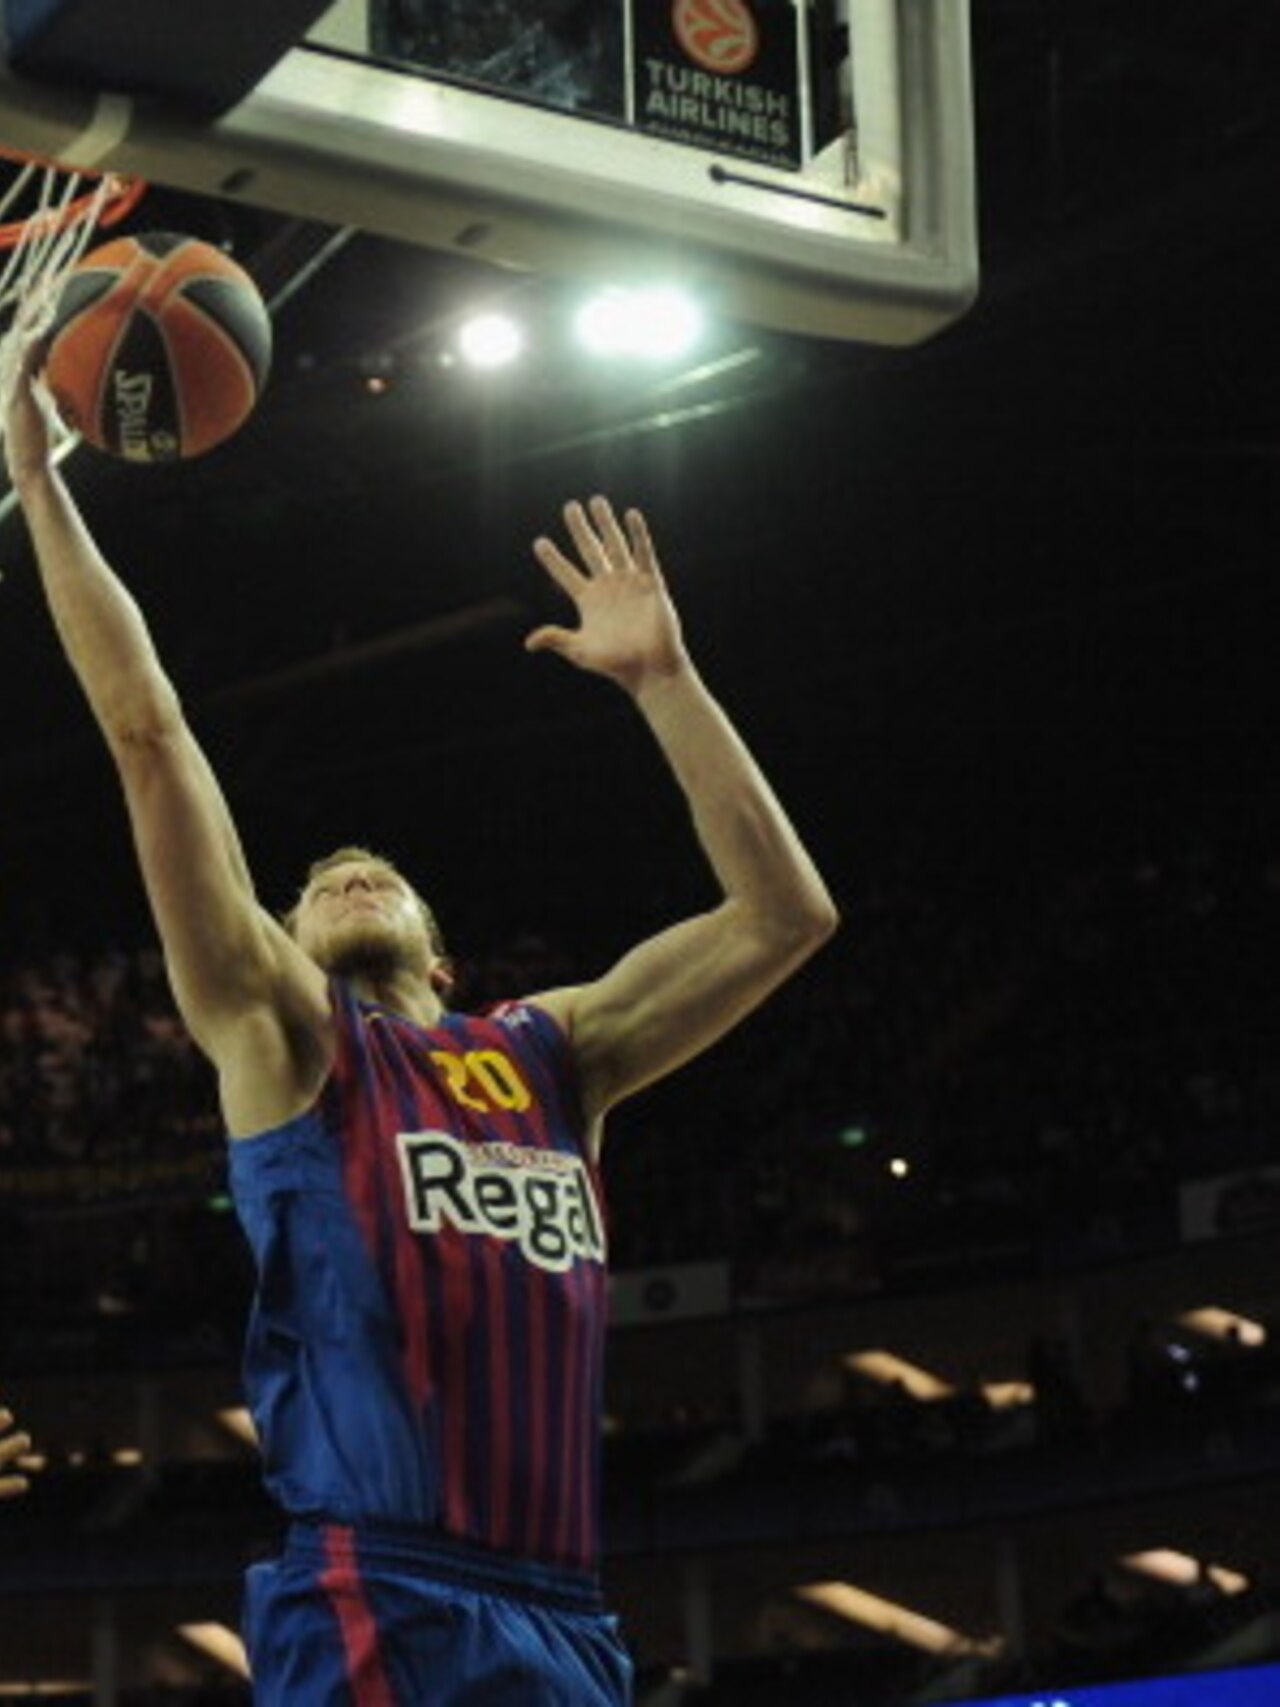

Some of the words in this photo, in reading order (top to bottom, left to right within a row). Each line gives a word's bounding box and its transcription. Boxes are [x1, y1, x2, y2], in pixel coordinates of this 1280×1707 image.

[645, 57, 789, 118] TURKISH
[646, 89, 790, 147] AIRLINES
[430, 1049, 532, 1112] 20
